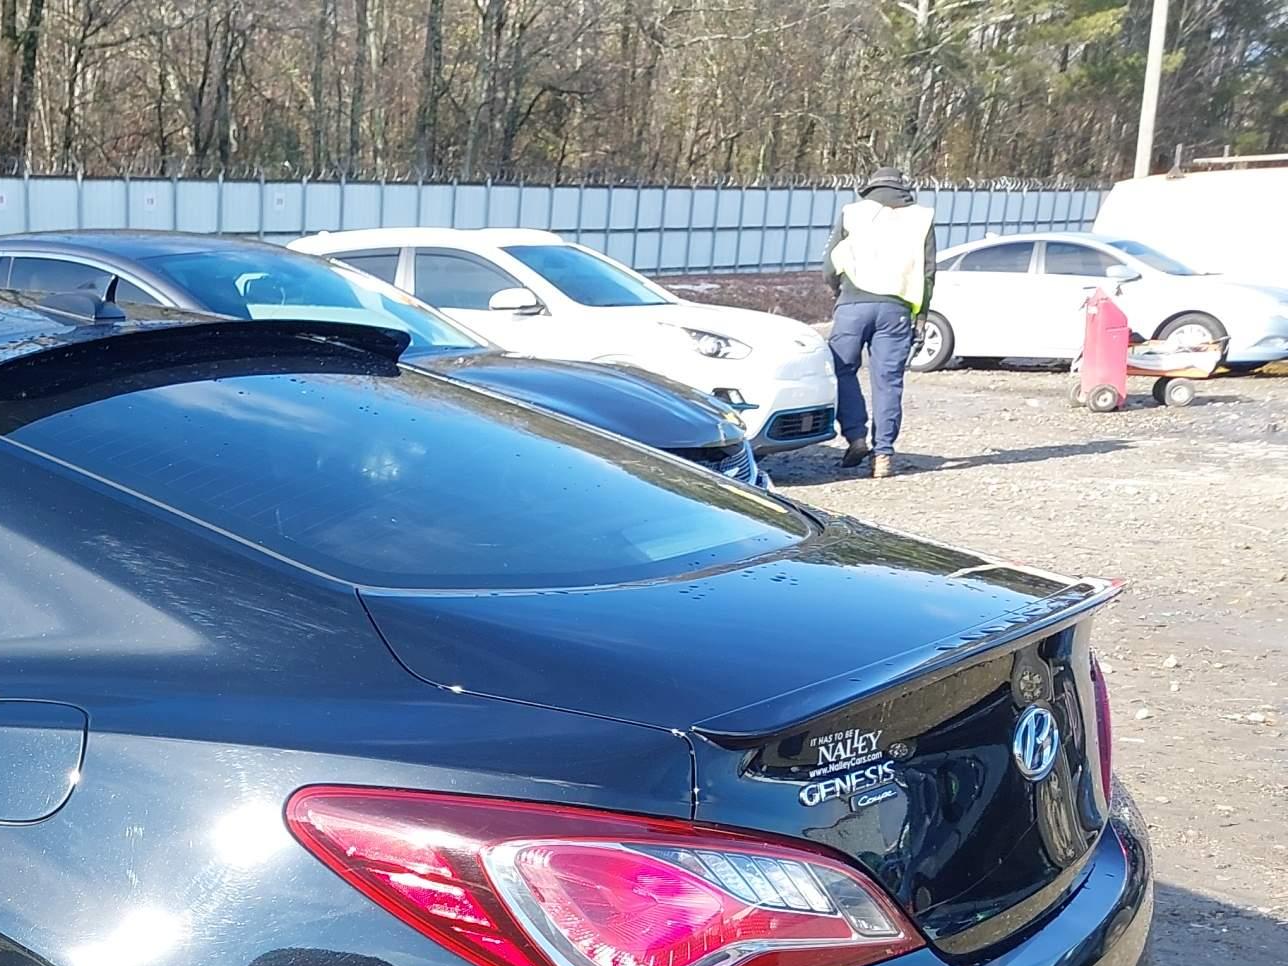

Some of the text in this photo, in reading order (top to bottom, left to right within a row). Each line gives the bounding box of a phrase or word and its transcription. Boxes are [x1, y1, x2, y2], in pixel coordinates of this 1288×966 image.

[809, 729, 854, 747] IT HAS TO BE
[816, 728, 883, 766] NALLEY
[809, 751, 883, 778] www.NalleyCars.com
[799, 760, 896, 806] GENESIS
[857, 789, 897, 806] Coupe
